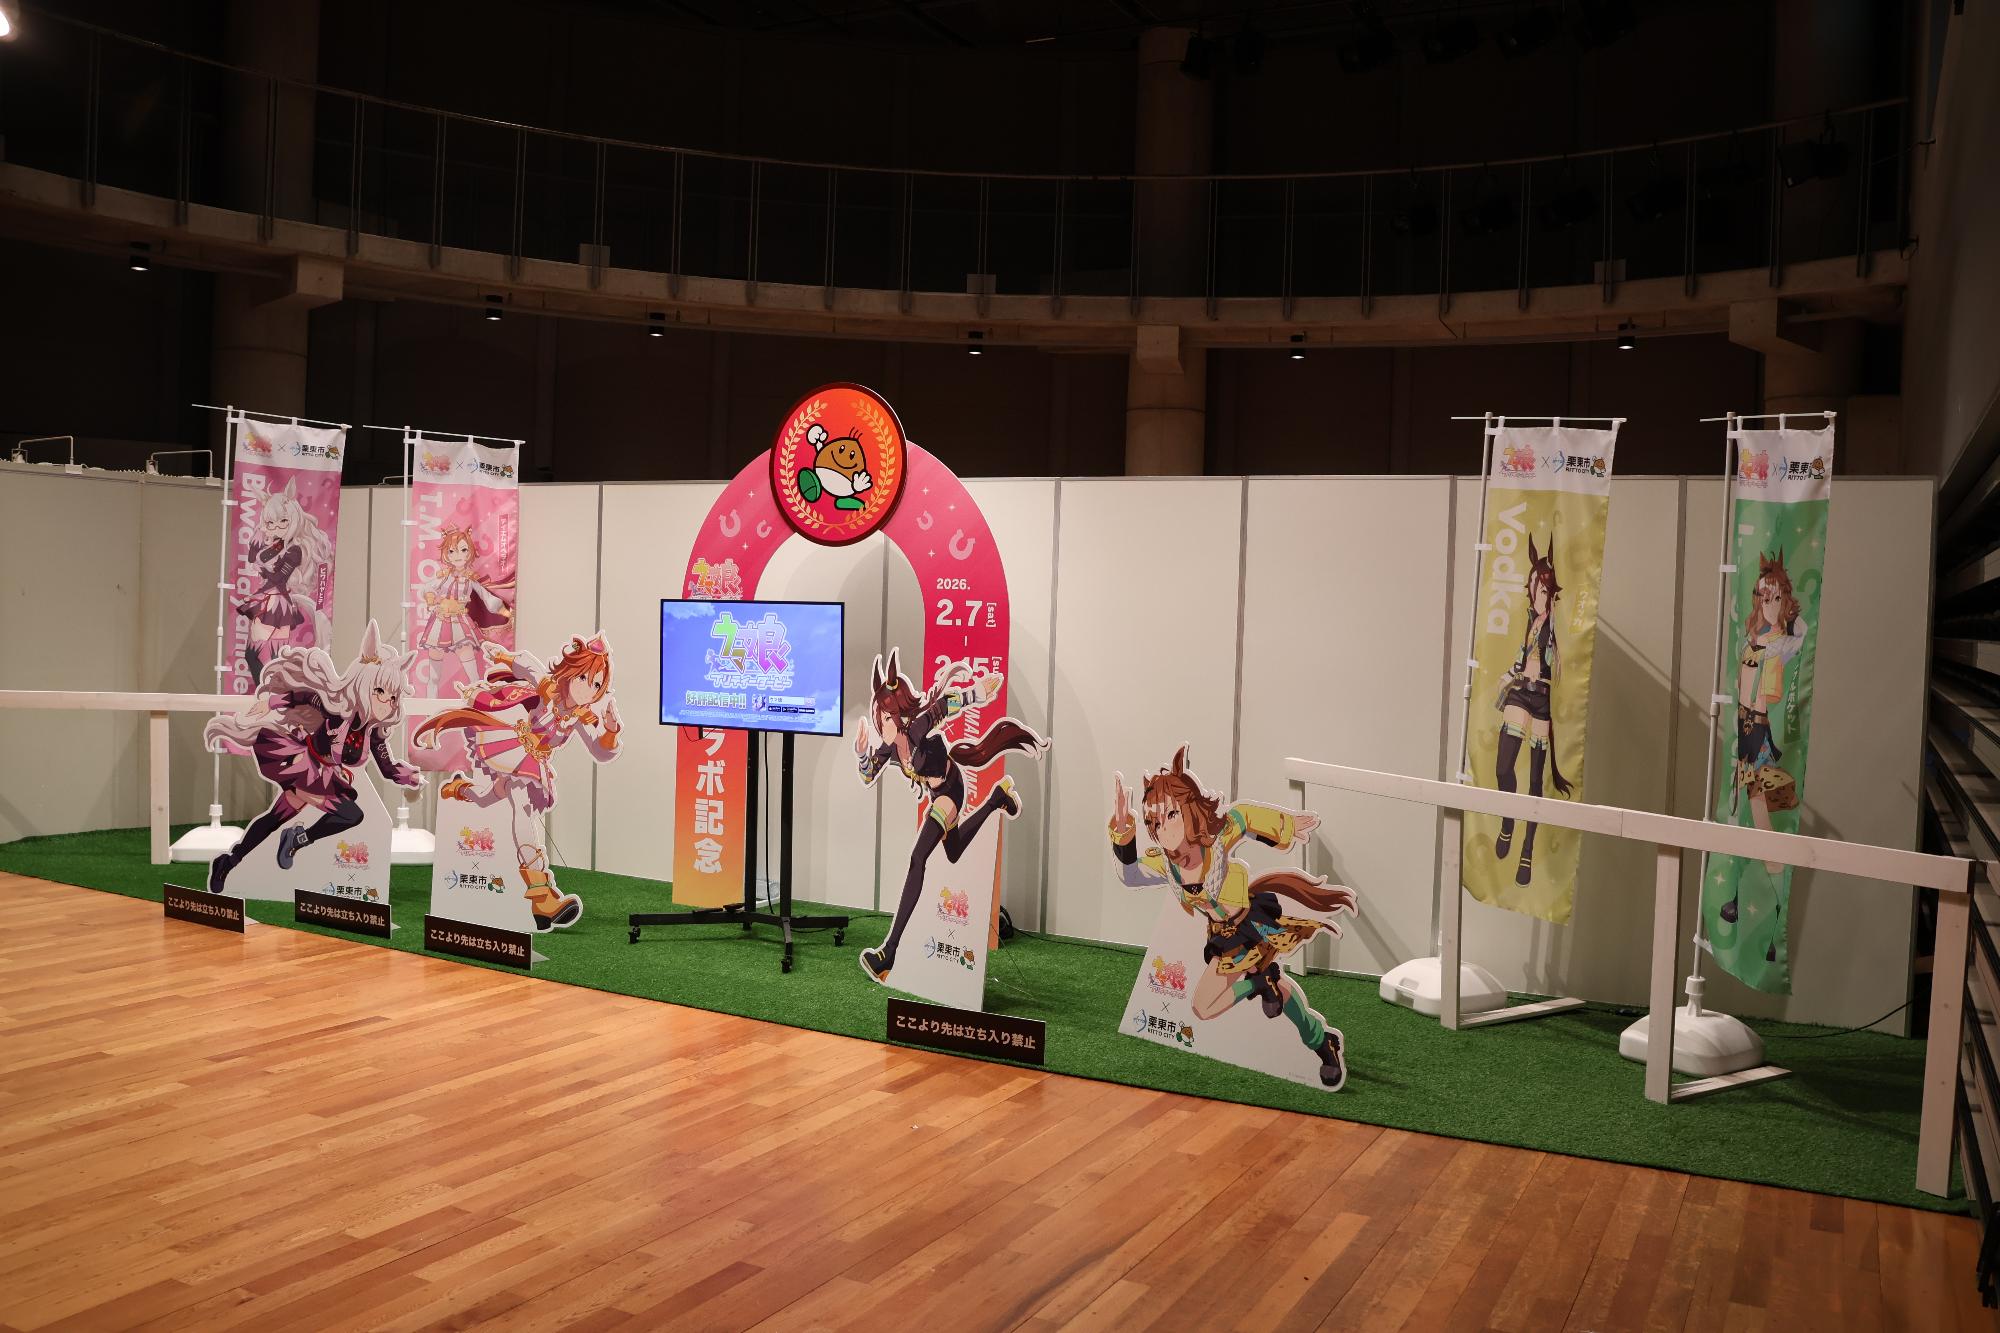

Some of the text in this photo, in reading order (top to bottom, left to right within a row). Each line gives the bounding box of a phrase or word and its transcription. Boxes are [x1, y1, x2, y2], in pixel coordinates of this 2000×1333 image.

[1789, 461, 1812, 474] 栗東
[238, 472, 266, 545] Biwa
[418, 491, 444, 550] T.M.
[1486, 501, 1528, 636] Vodka
[936, 577, 971, 590] 2026.
[936, 598, 997, 628] 2.7 [sat]
[167, 896, 240, 921] ここより先は立ち入り禁止
[300, 902, 386, 927] ここより先は立ち入り禁止
[430, 929, 525, 957] ここより先は立ち入り禁止
[896, 1015, 1036, 1050] ここより先は立ち入り禁止
[1147, 1015, 1177, 1034] 栗東市
